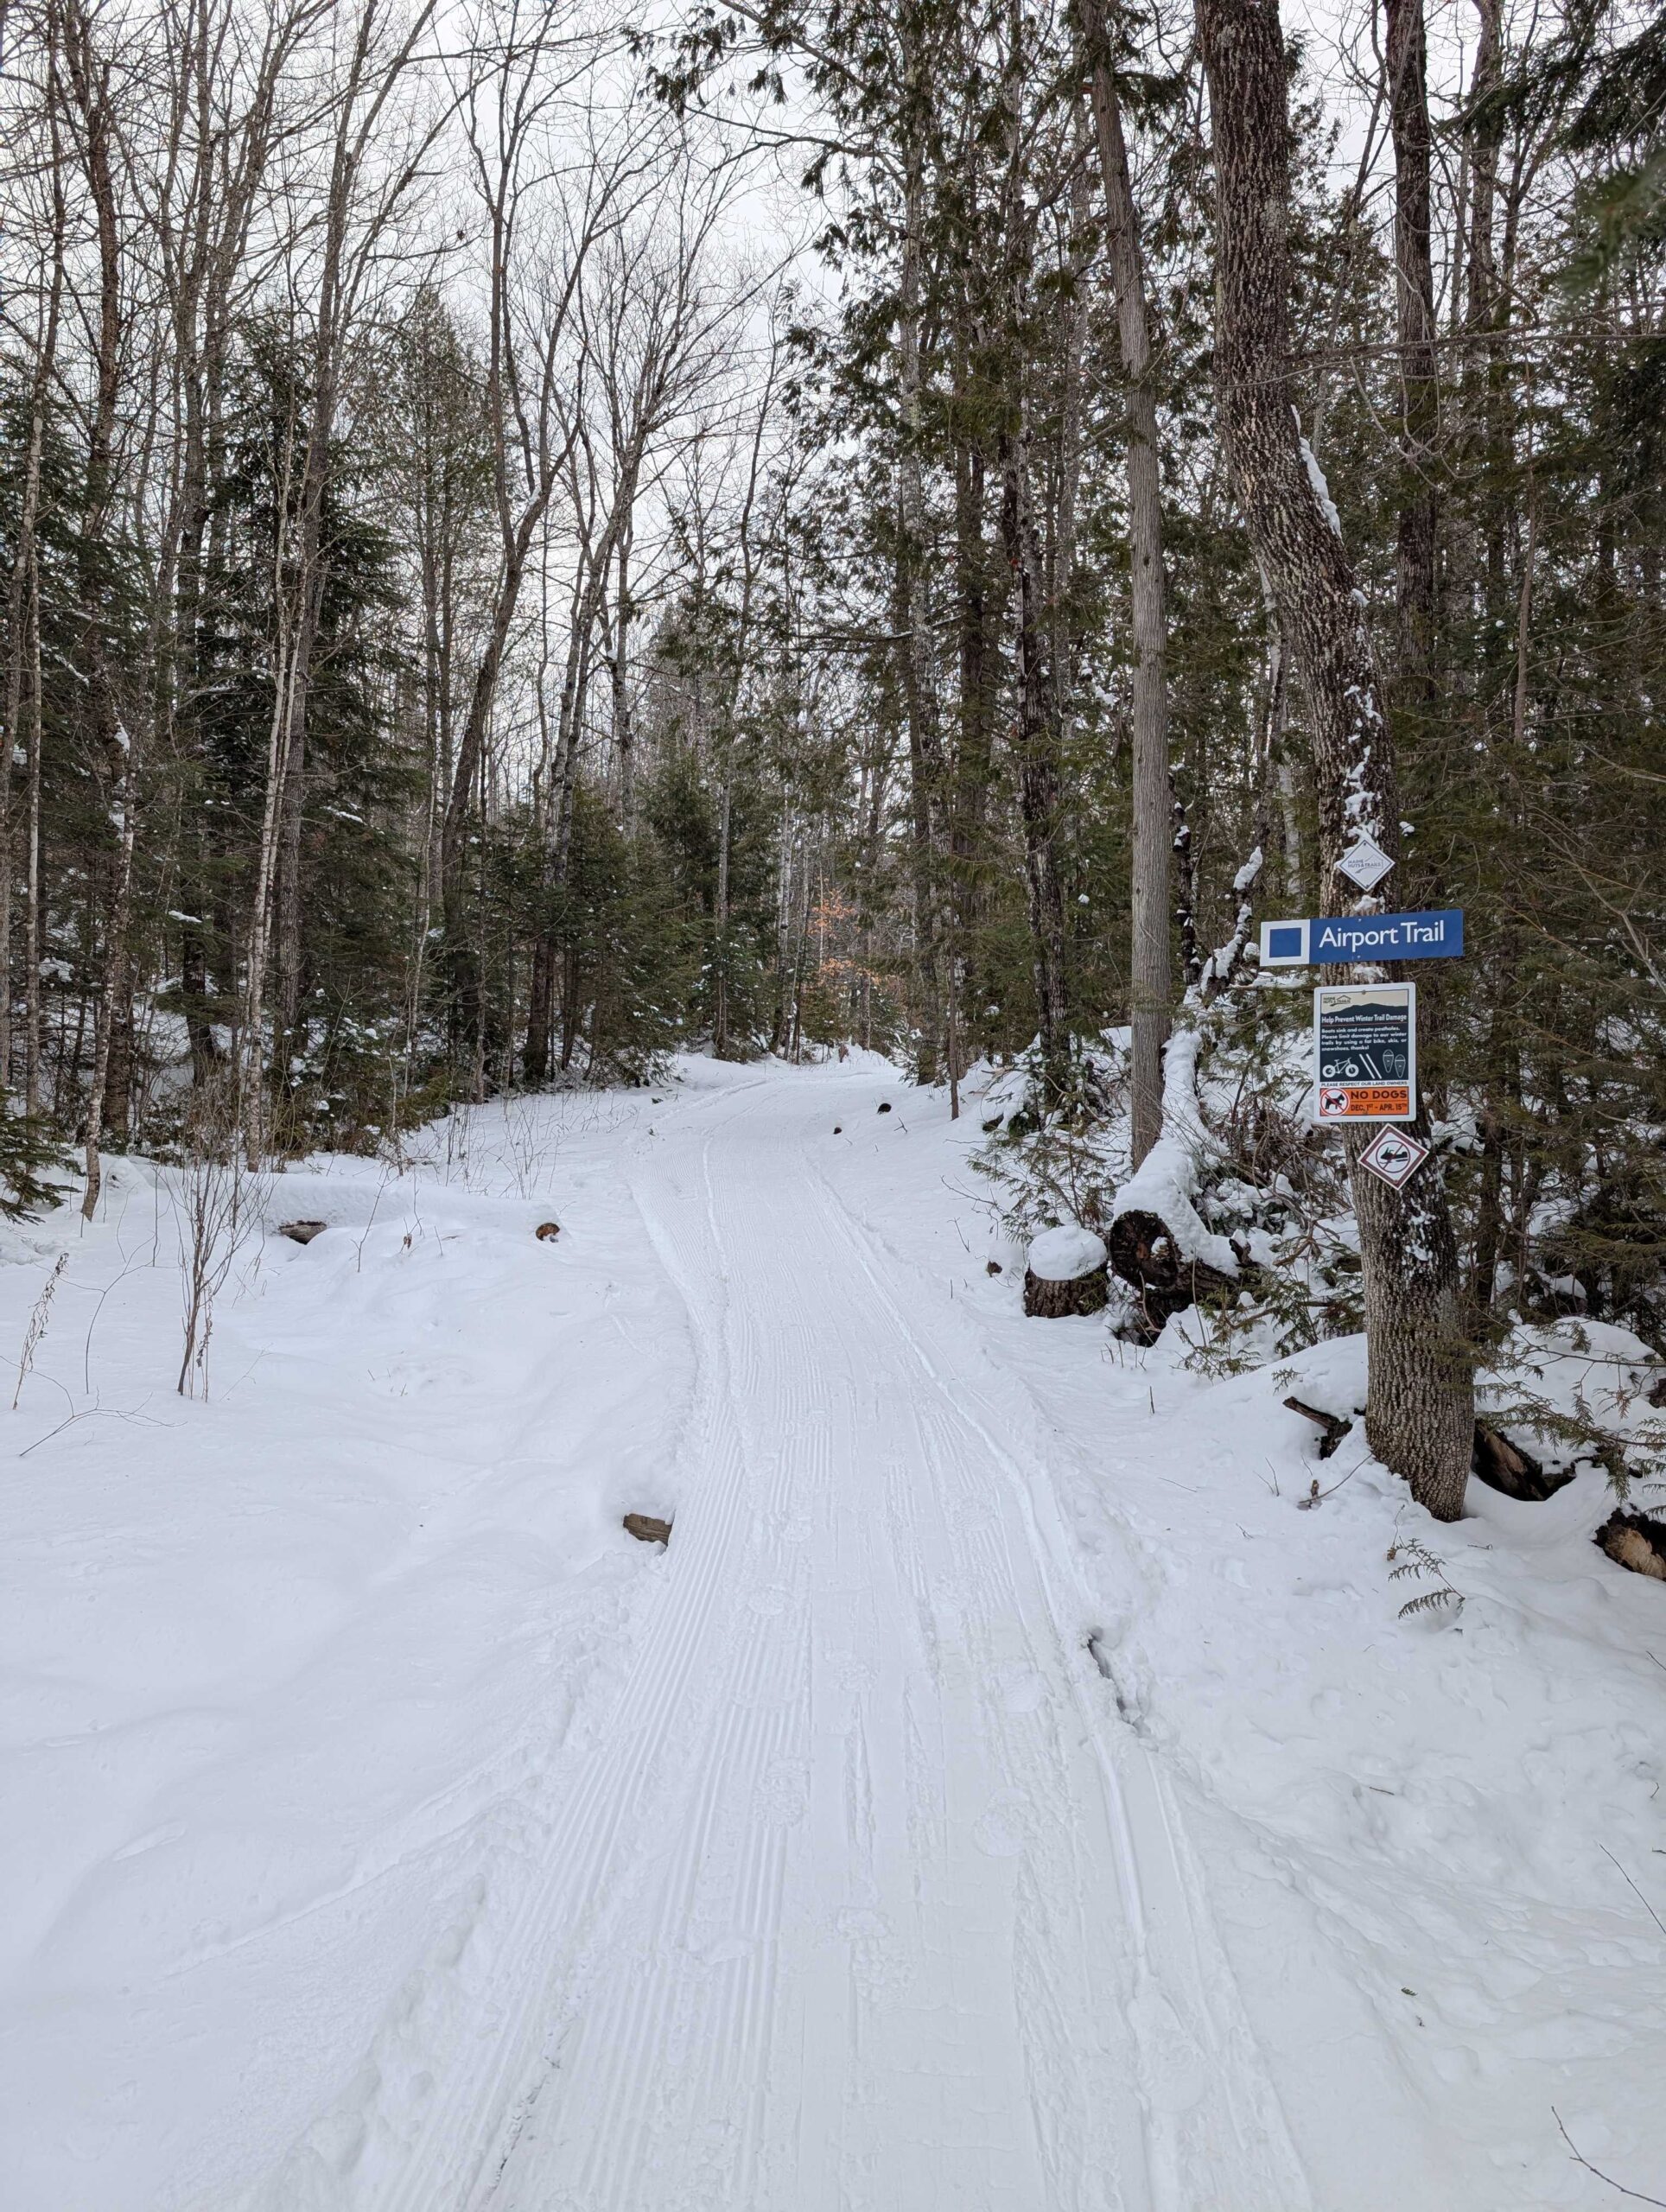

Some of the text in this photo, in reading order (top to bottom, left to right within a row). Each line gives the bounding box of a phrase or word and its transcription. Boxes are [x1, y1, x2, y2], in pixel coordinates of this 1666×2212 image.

[1319, 919, 1445, 953] Airport Trail
[1322, 1016, 1335, 1025] Help
[1386, 1014, 1407, 1022] Damage
[1351, 1090, 1407, 1099] NO DOGS
